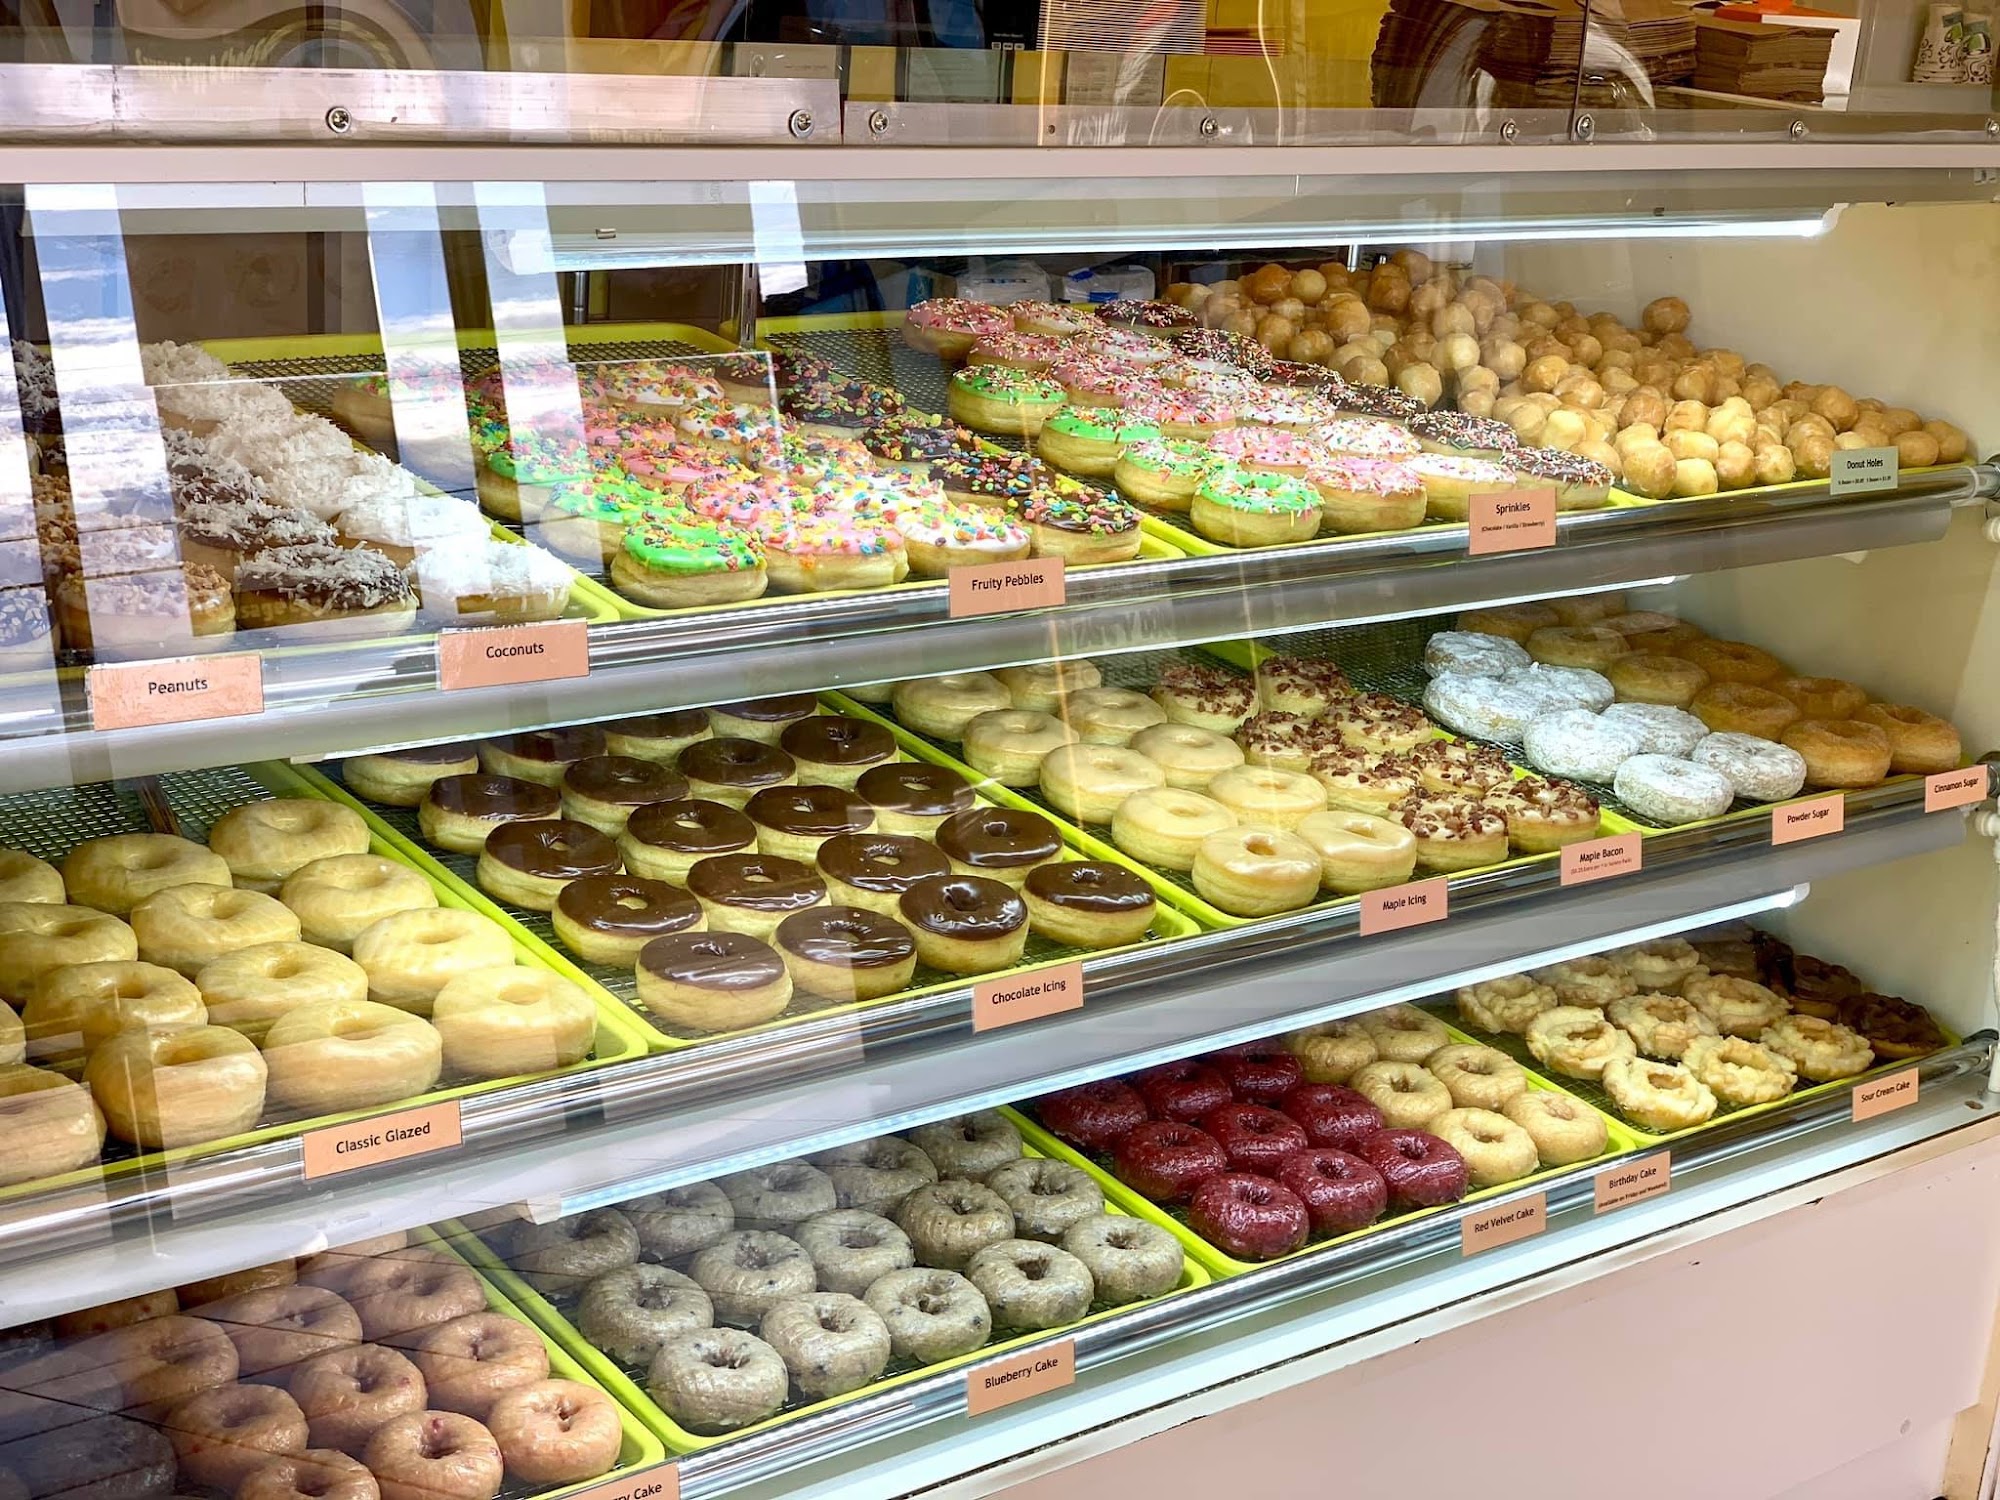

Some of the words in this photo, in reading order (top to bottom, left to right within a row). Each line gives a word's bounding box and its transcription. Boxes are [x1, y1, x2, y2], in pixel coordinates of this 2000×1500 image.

[1846, 459, 1865, 469] Donut
[1866, 458, 1884, 468] Holes
[1495, 502, 1531, 516] Sprinkles
[972, 577, 1003, 591] Fruity
[1005, 573, 1044, 587] Pebbles
[486, 642, 545, 659] Coconuts
[148, 678, 208, 695] Peanuts
[1934, 781, 1963, 793] Cinnamon
[1963, 778, 1979, 788] Sugar
[1787, 812, 1811, 824] Powder
[1812, 808, 1830, 819] Sugar
[1579, 850, 1601, 863] Maple
[1602, 847, 1624, 858] Bacon
[1382, 898, 1406, 911] Maple
[1408, 894, 1427, 905] Icing
[992, 987, 1041, 1005] Chocolate
[1043, 980, 1067, 993] Icing
[1861, 1093, 1875, 1103] Sour
[1875, 1086, 1895, 1098] Cream
[1896, 1081, 1910, 1091] Cake
[335, 1134, 381, 1154] Classic
[385, 1121, 430, 1143] Glazed
[1609, 1173, 1639, 1189] Birthday
[1640, 1167, 1657, 1179] Cake
[1474, 1220, 1489, 1233] Red
[1490, 1213, 1515, 1227] Velvet
[1516, 1208, 1535, 1220] Cake
[985, 1367, 1033, 1389] Blueberry
[1035, 1358, 1059, 1373] Cake
[634, 1483, 662, 1500] Cake
